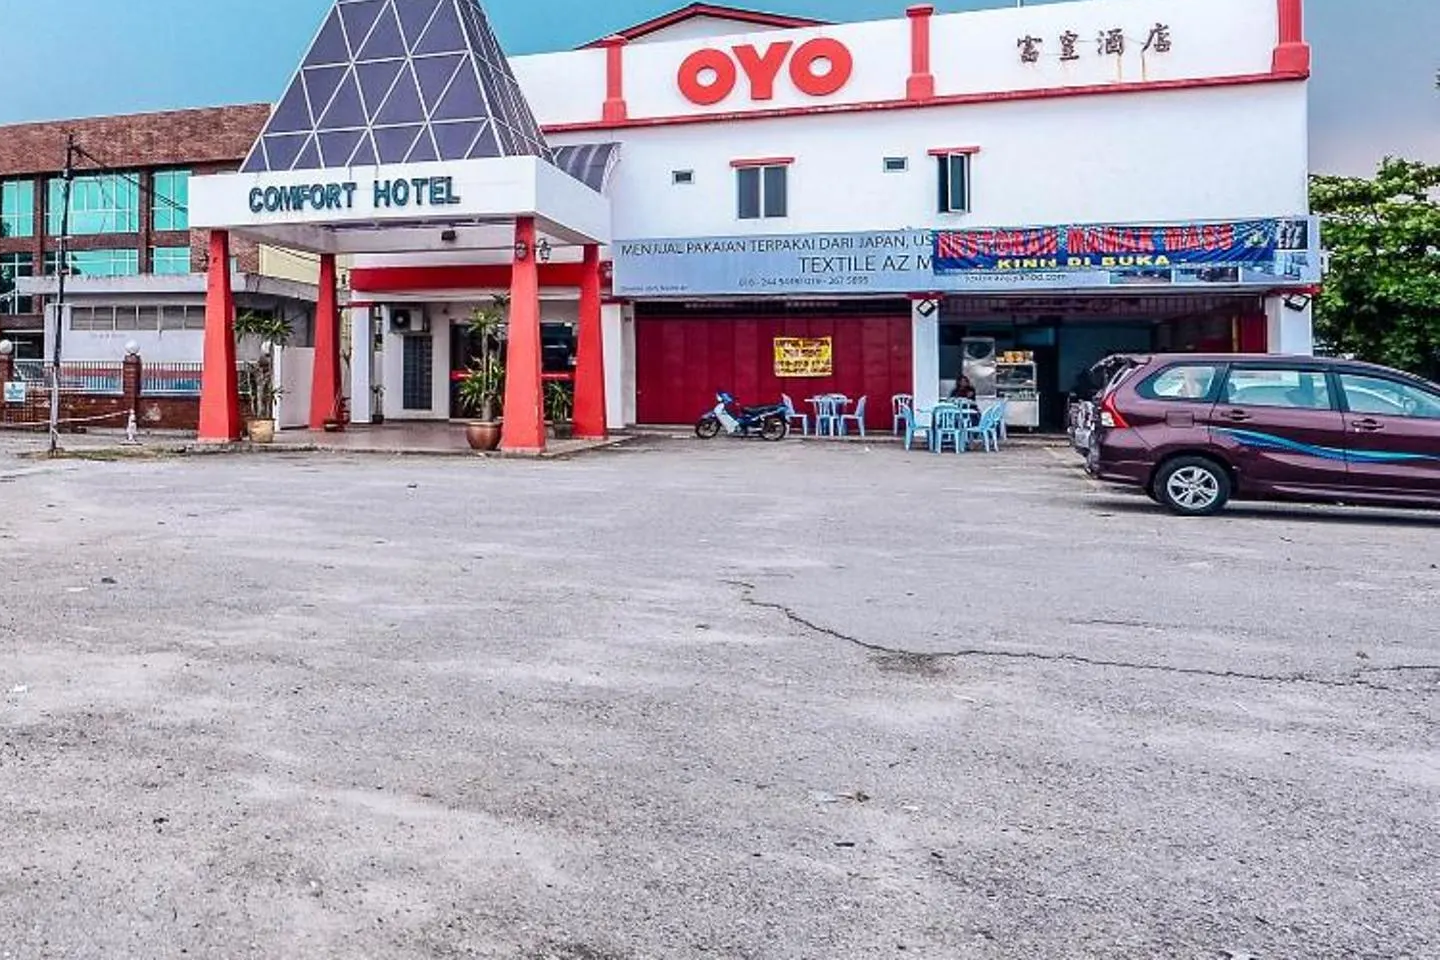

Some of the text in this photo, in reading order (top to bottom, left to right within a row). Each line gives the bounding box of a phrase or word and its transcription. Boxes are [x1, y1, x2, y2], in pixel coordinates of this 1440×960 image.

[677, 38, 853, 106] OYO
[249, 176, 460, 213] COMFORT HOTEL
[686, 240, 746, 254] PAKAIAN
[751, 237, 815, 253] TERPAKAI
[819, 237, 853, 250] DARI
[798, 255, 876, 274] TEXTILE
[881, 253, 909, 272] AZ
[1066, 256, 1092, 267] DI
[1101, 253, 1170, 267] BUKA
